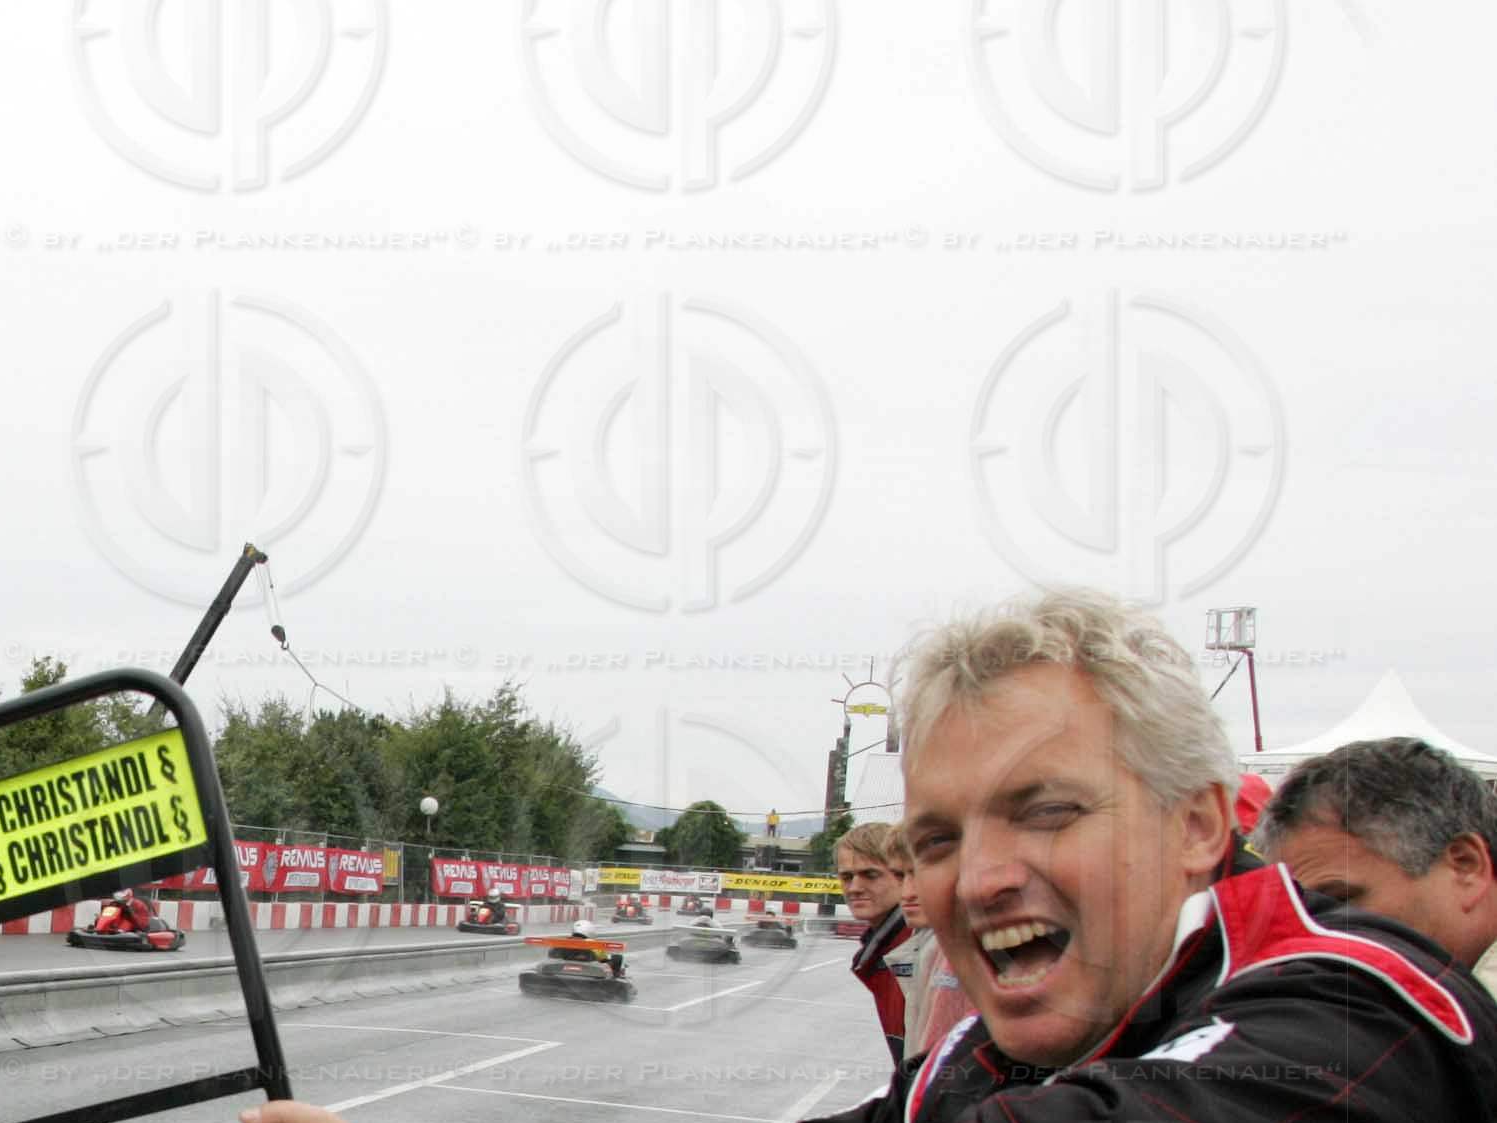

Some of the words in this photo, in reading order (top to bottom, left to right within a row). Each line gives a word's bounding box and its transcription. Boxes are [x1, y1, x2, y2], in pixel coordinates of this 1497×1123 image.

[8, 801, 170, 885] CHRISTANDL
[280, 848, 326, 868] REMUS
[339, 854, 383, 874] REMUS
[733, 877, 789, 888] DUNLOP
